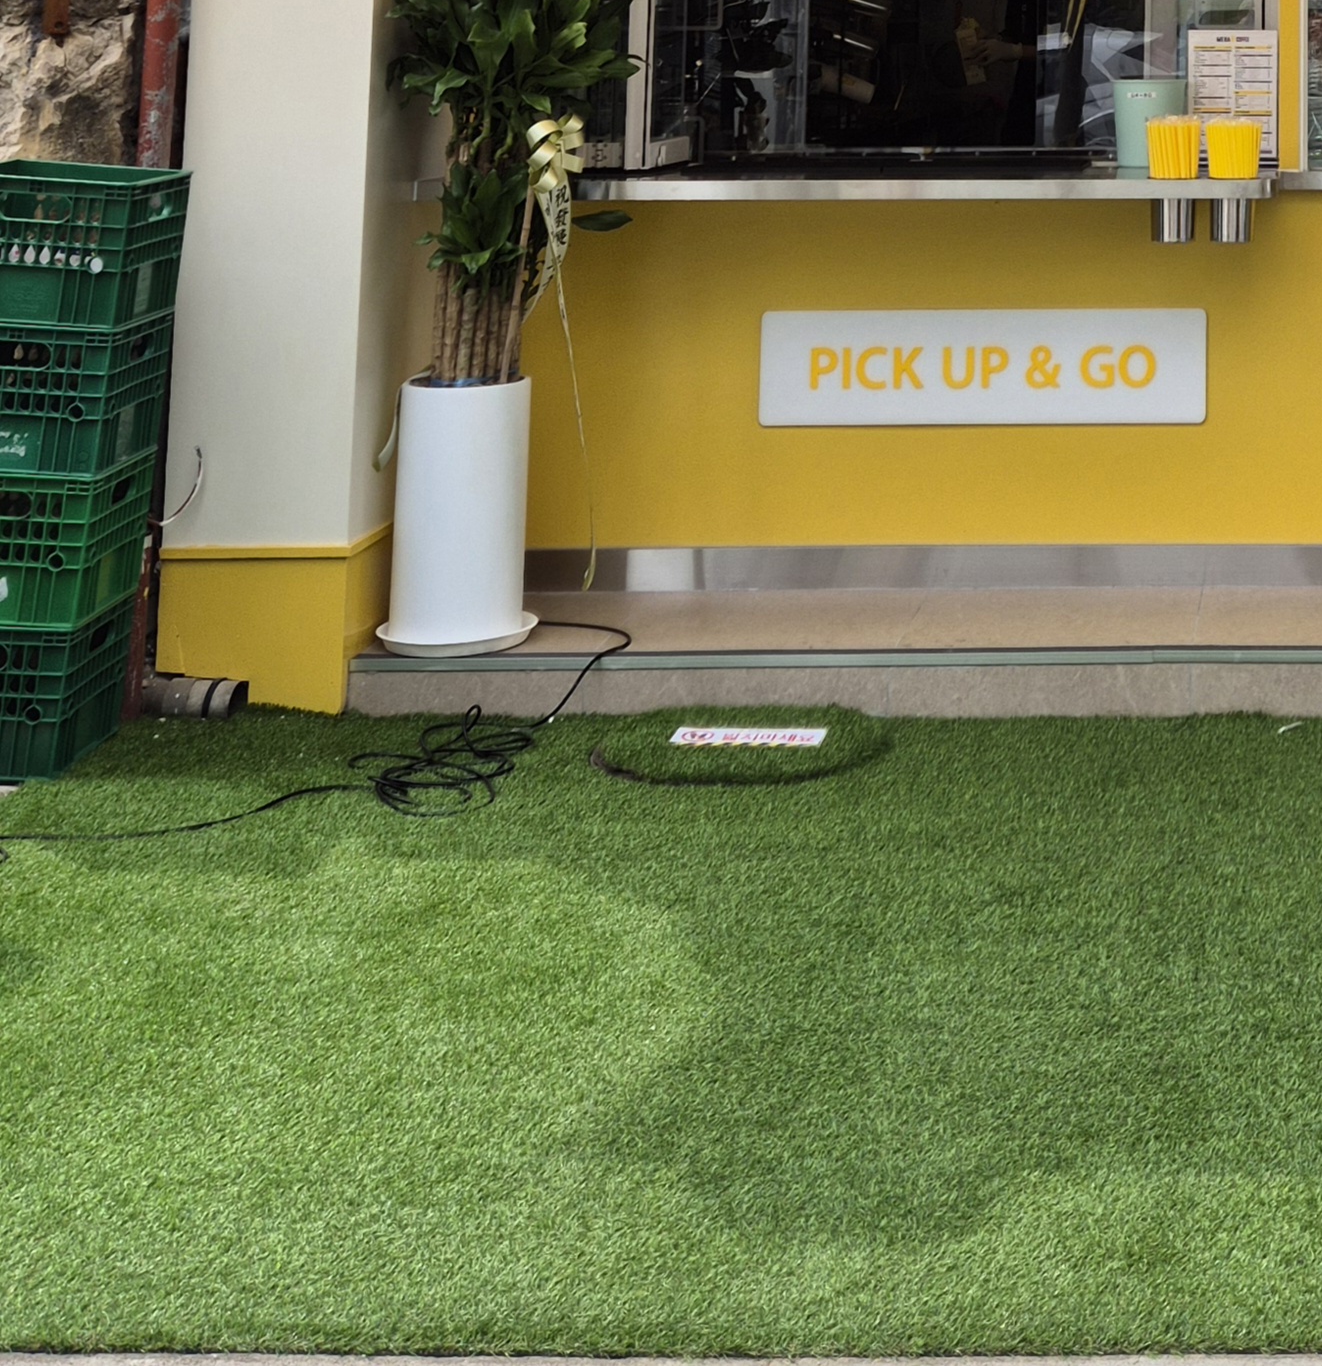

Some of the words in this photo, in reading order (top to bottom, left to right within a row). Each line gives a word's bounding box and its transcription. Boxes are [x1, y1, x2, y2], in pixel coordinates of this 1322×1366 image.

[809, 346, 925, 390] PICK
[942, 345, 1010, 390] UP
[1025, 344, 1062, 390] &
[1079, 344, 1157, 390] GO
